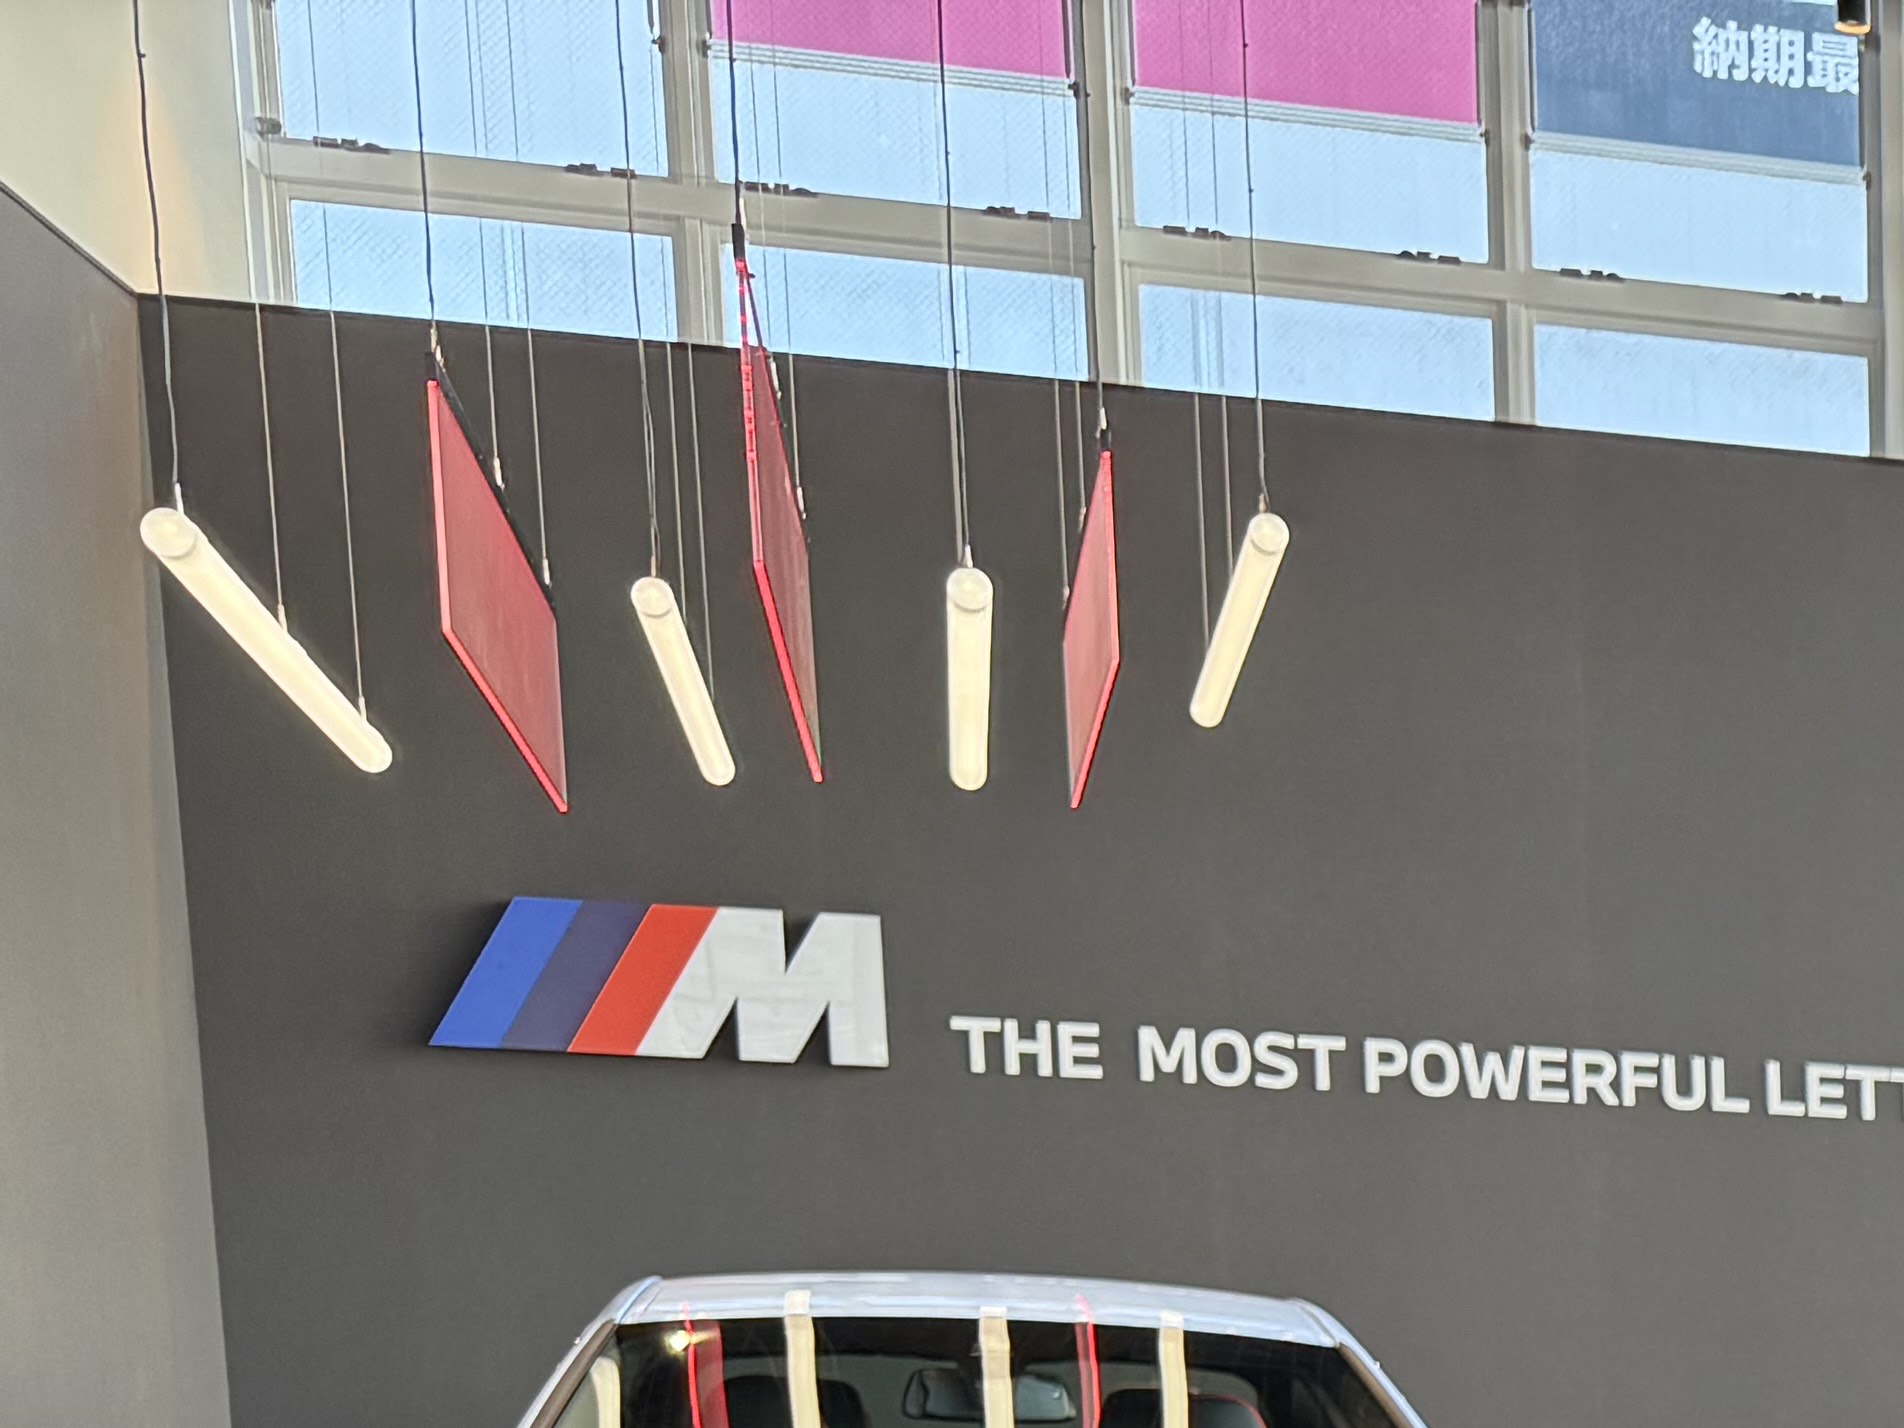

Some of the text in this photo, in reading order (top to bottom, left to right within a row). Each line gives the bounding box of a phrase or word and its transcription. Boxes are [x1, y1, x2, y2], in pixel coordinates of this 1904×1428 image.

[949, 1015, 1104, 1080] THE
[1138, 1024, 1346, 1092] MOST
[1363, 1037, 1750, 1114] POWERFUL
